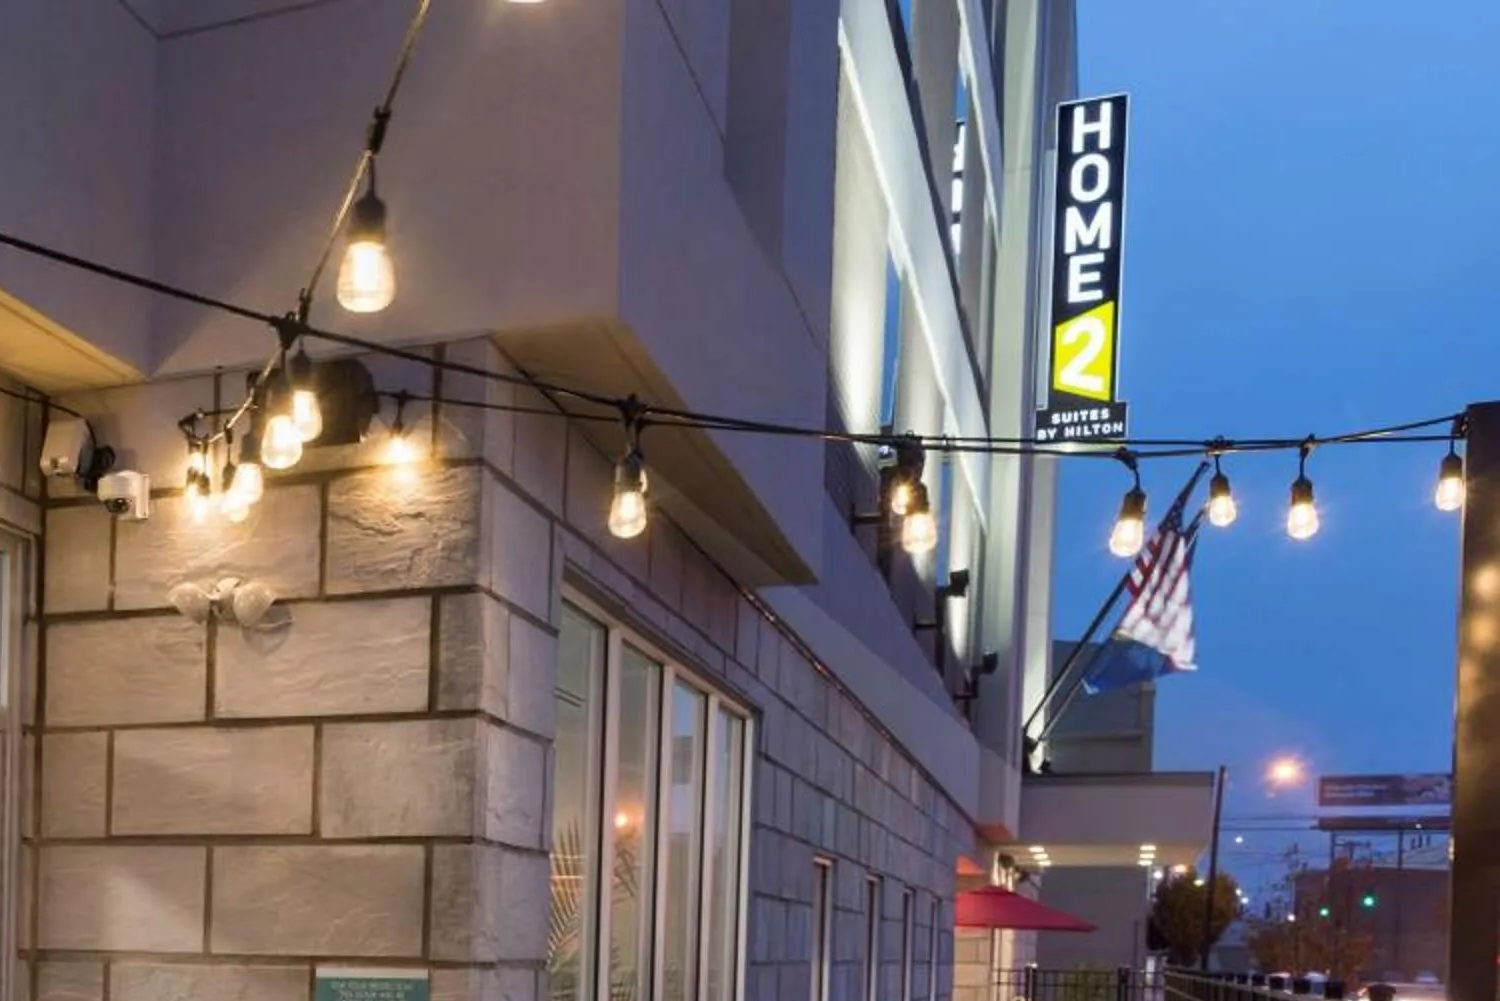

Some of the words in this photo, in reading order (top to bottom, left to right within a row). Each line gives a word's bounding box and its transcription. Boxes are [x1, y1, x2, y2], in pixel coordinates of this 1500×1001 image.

[1063, 101, 1114, 304] HOME
[1059, 315, 1106, 392] 2
[1037, 427, 1058, 441] BY
[1064, 420, 1124, 438] HILTON
[1051, 407, 1111, 425] SUITES
